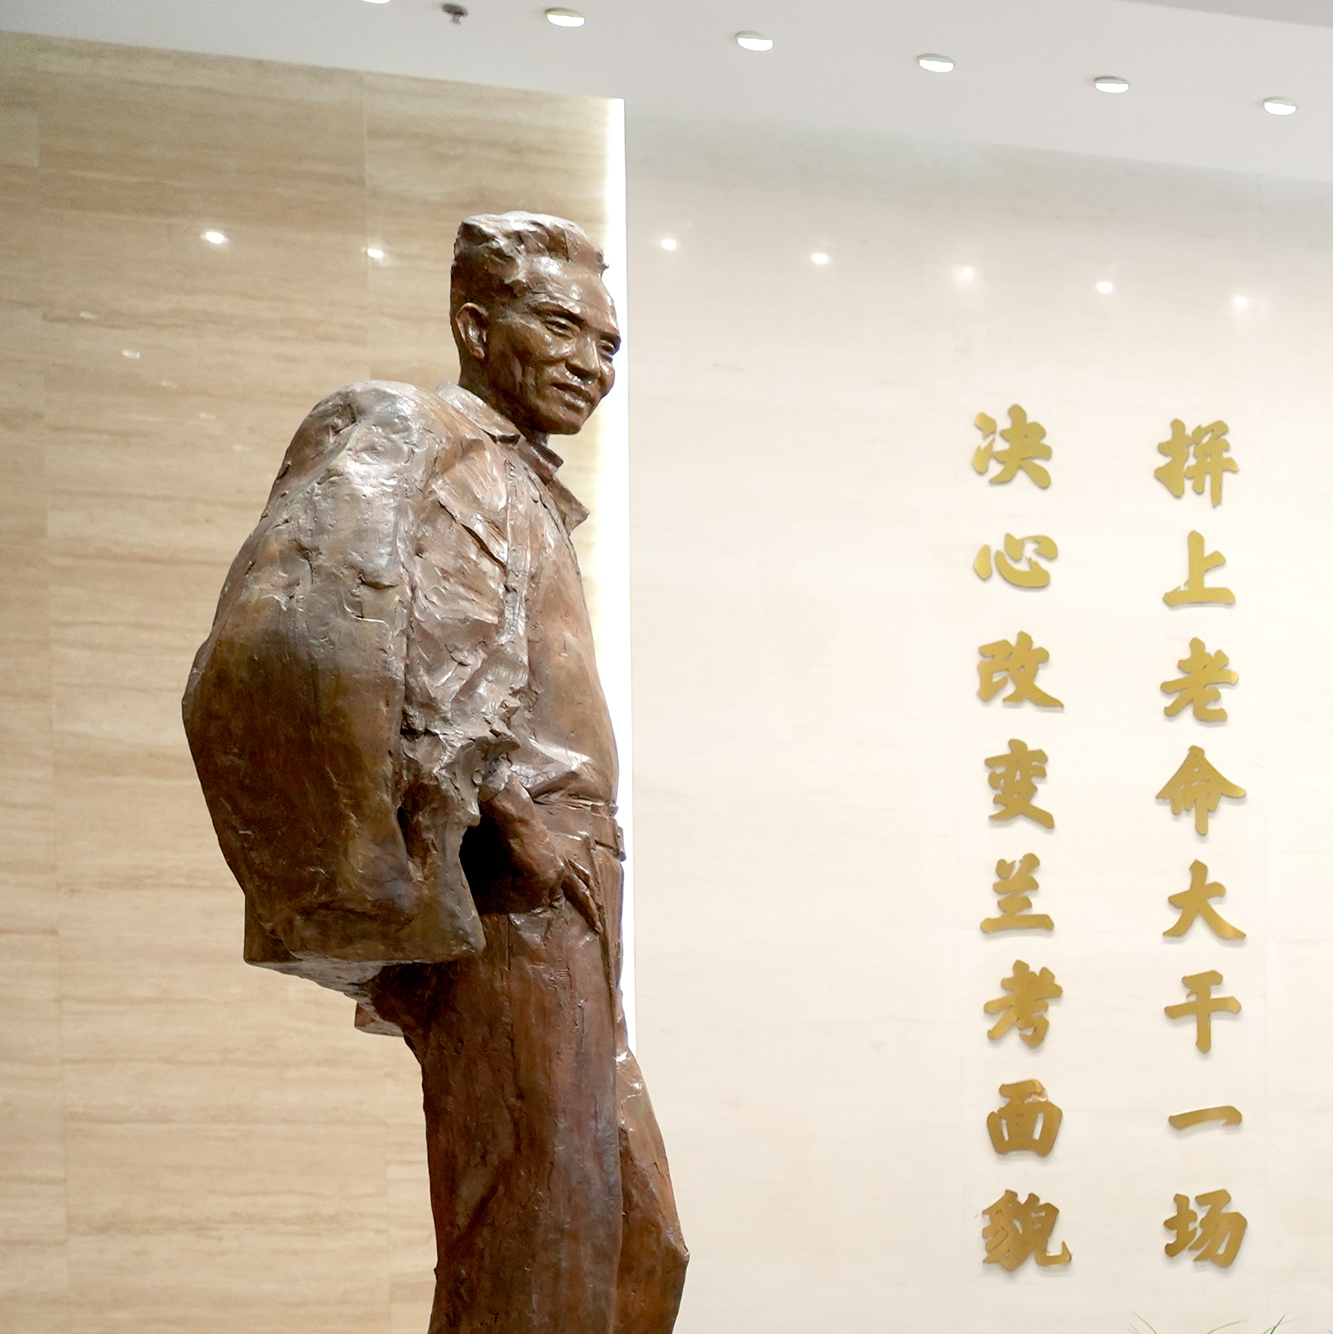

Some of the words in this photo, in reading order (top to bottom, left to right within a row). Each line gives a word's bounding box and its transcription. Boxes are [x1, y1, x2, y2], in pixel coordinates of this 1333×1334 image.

[971, 404, 1073, 1269] 决心改变兰考面貌
[1155, 418, 1248, 1269] 拼上老命大干一场
